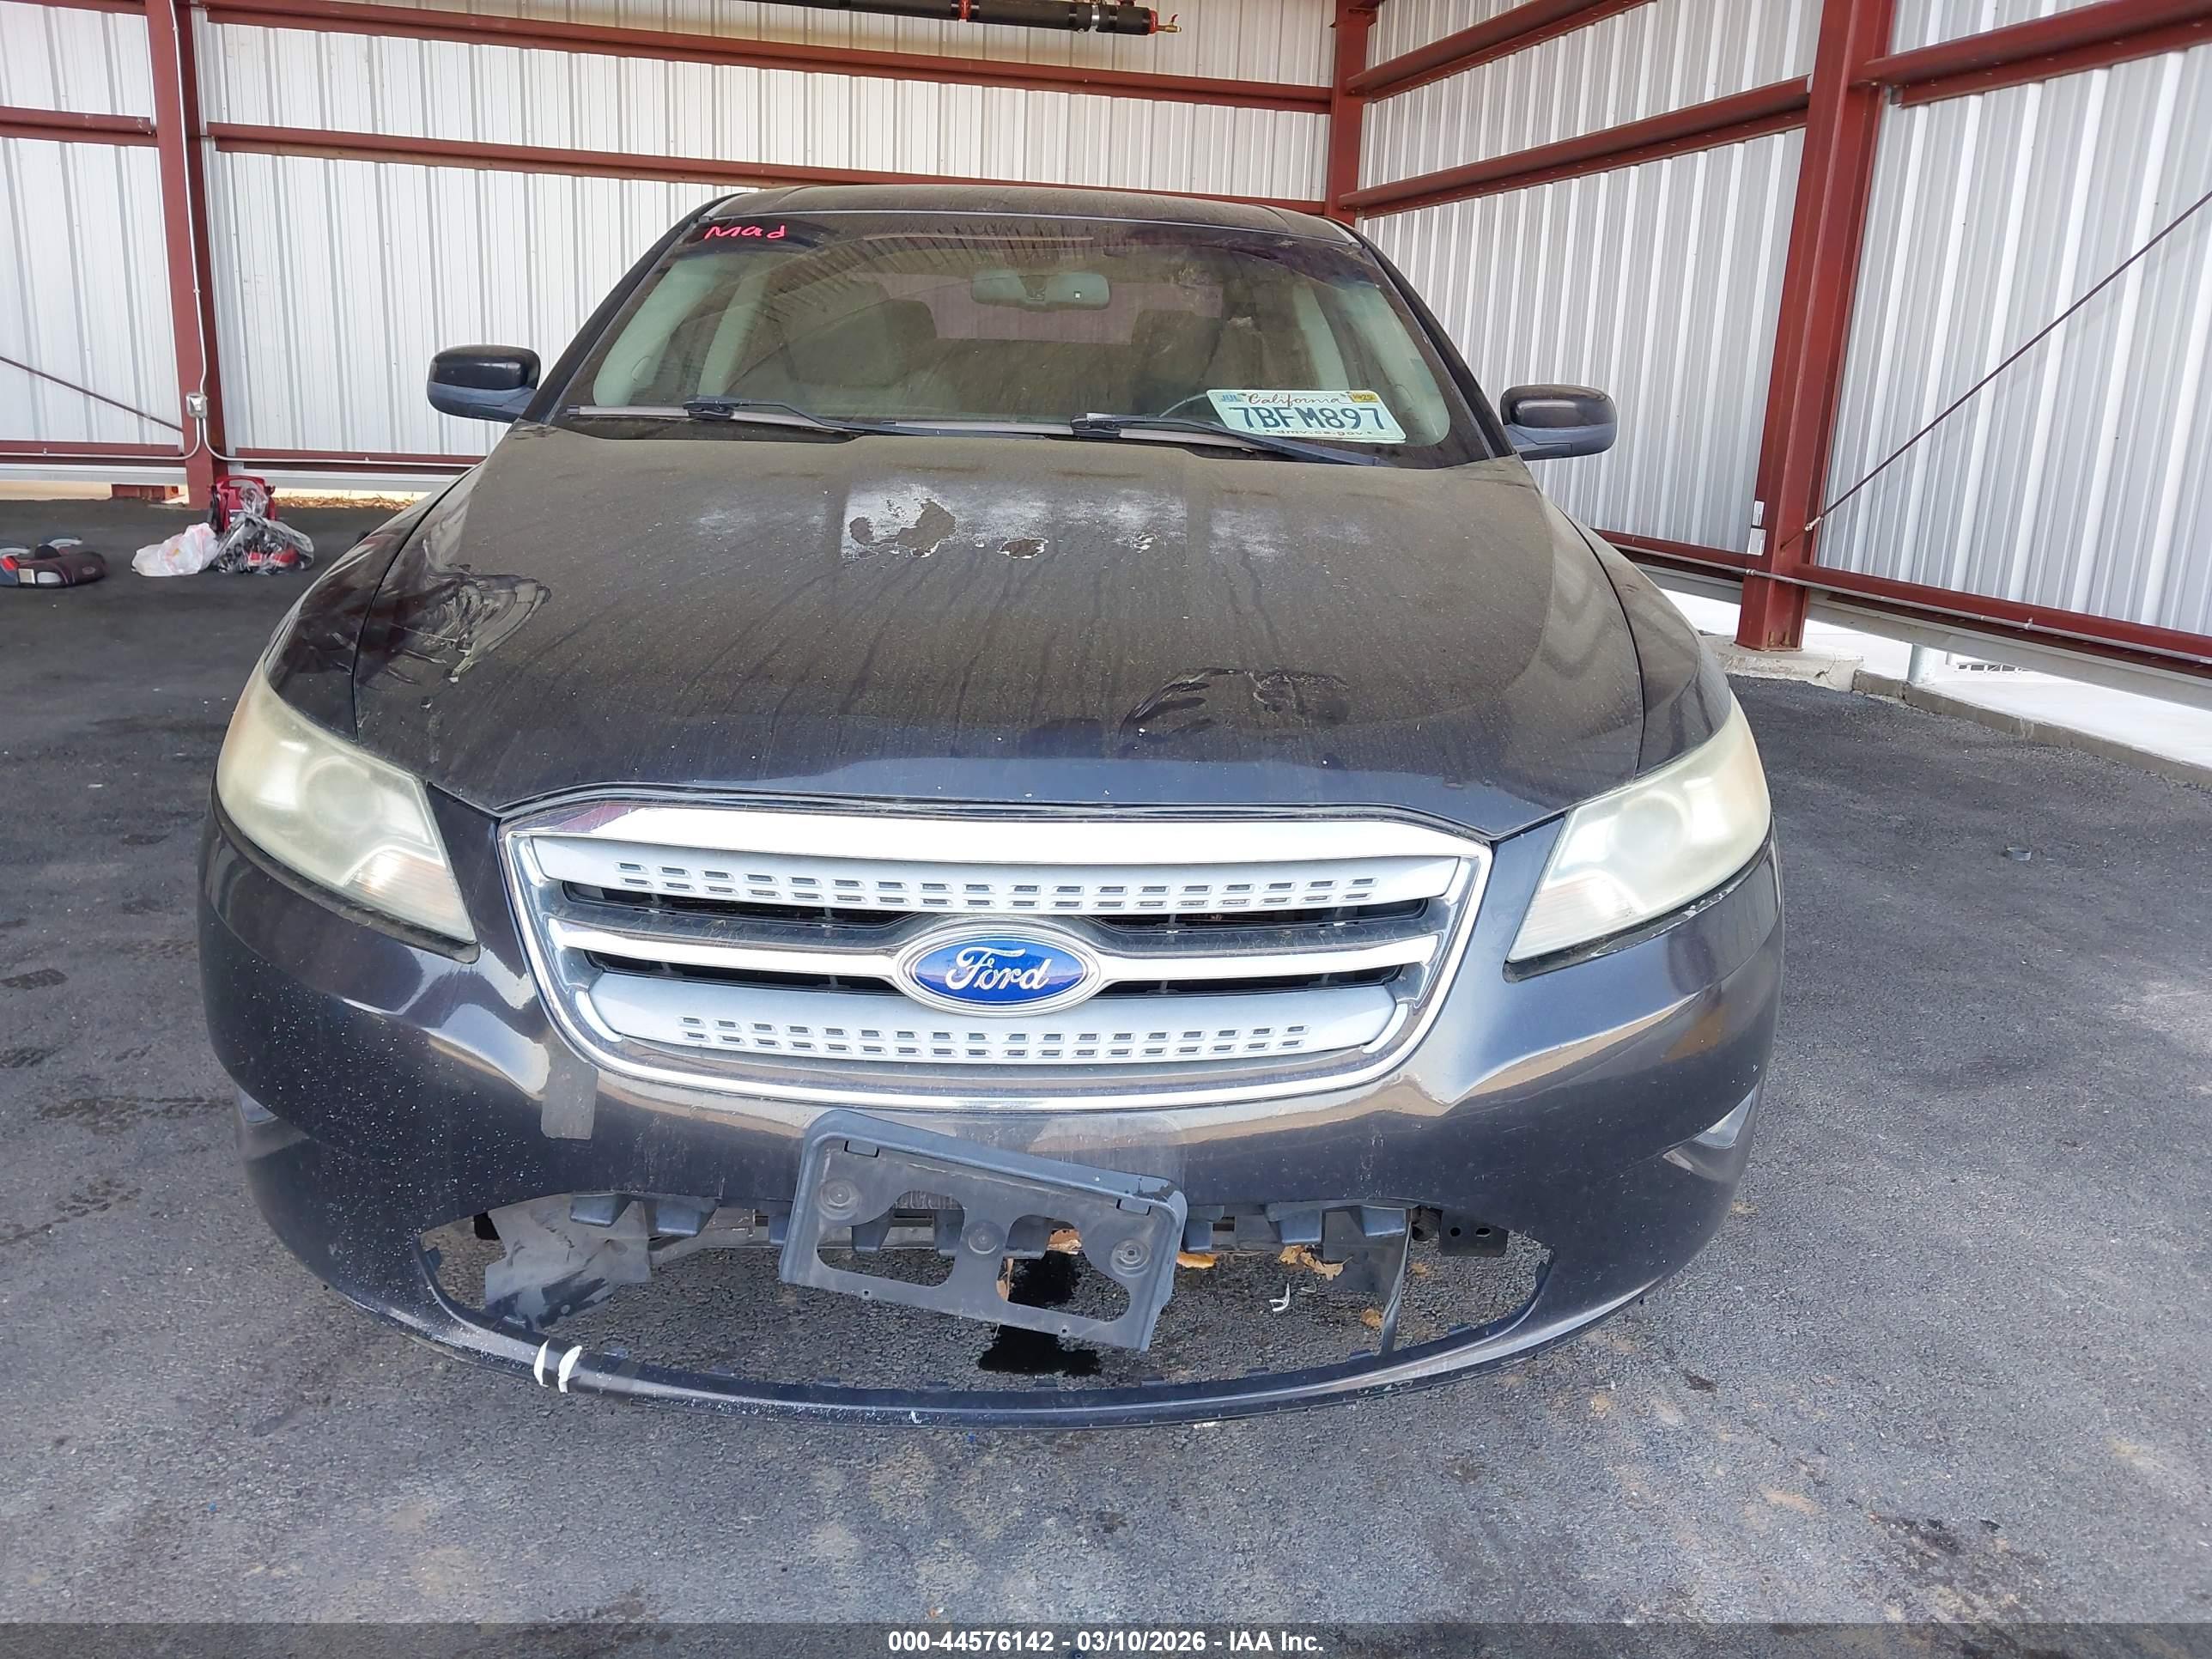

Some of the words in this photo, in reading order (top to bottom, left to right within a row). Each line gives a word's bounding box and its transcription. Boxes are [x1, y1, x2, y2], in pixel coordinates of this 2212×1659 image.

[1248, 392, 1350, 408] California
[1229, 406, 1385, 430] 7BFM897
[945, 945, 1053, 991] Ford
